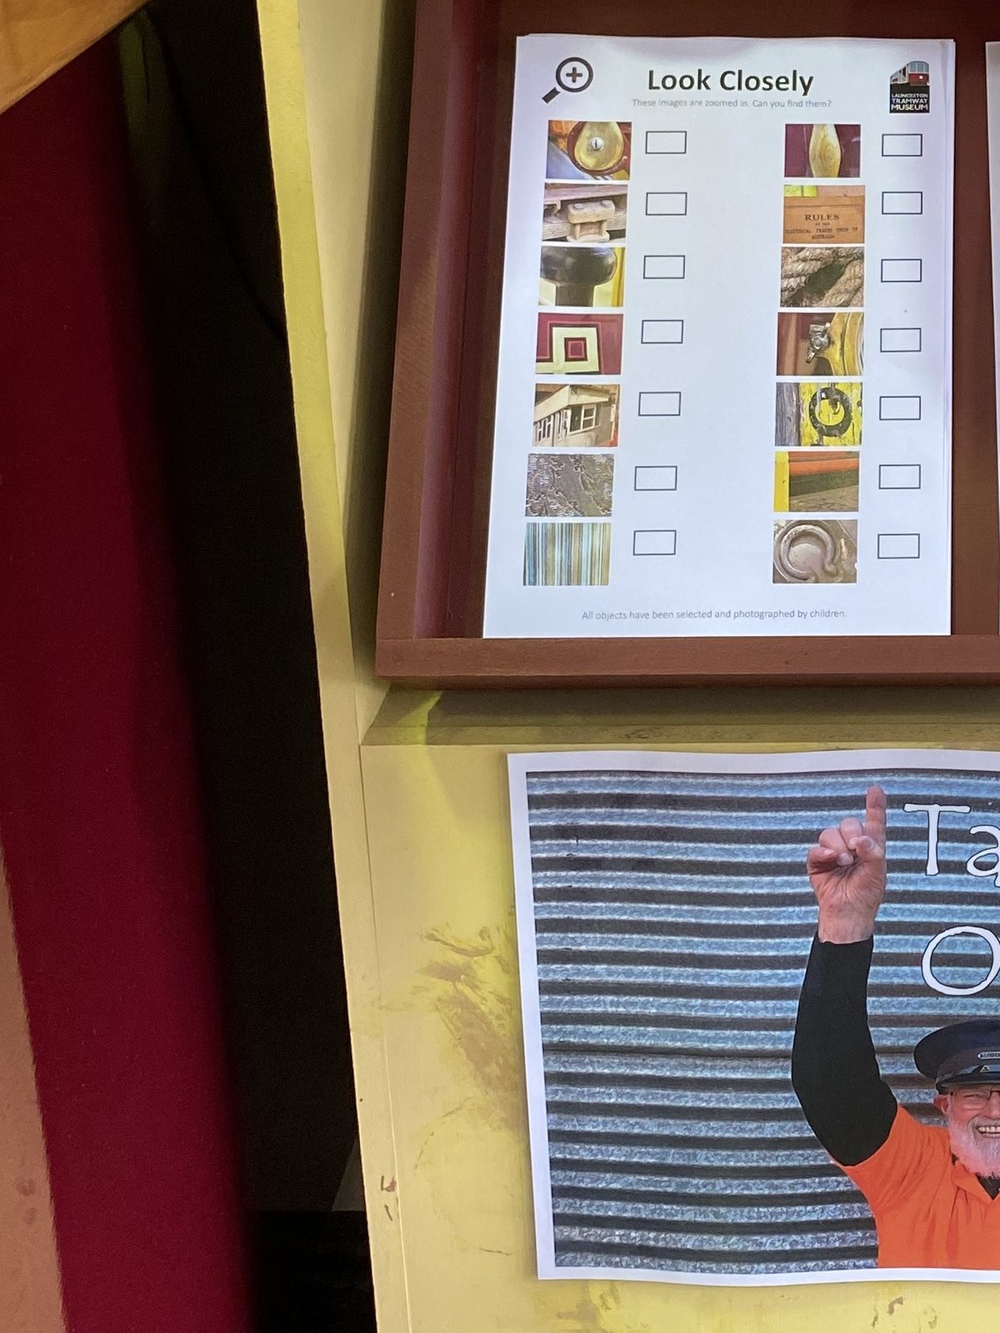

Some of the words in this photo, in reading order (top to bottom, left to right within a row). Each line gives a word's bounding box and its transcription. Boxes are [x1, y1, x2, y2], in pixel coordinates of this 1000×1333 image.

[648, 68, 711, 90] Look
[719, 69, 814, 96] Closely
[632, 99, 656, 108] These
[659, 99, 687, 108] images
[705, 99, 738, 107] zoomed
[770, 101, 785, 109] you
[787, 99, 803, 108] find
[805, 100, 832, 108] them?
[582, 611, 593, 620] All
[595, 611, 627, 621] objects
[629, 610, 650, 619] have
[652, 610, 674, 619] been
[676, 609, 712, 619] selected
[715, 609, 731, 618] and
[733, 609, 795, 620] photographed
[797, 609, 808, 620] by
[809, 609, 848, 618] children.
